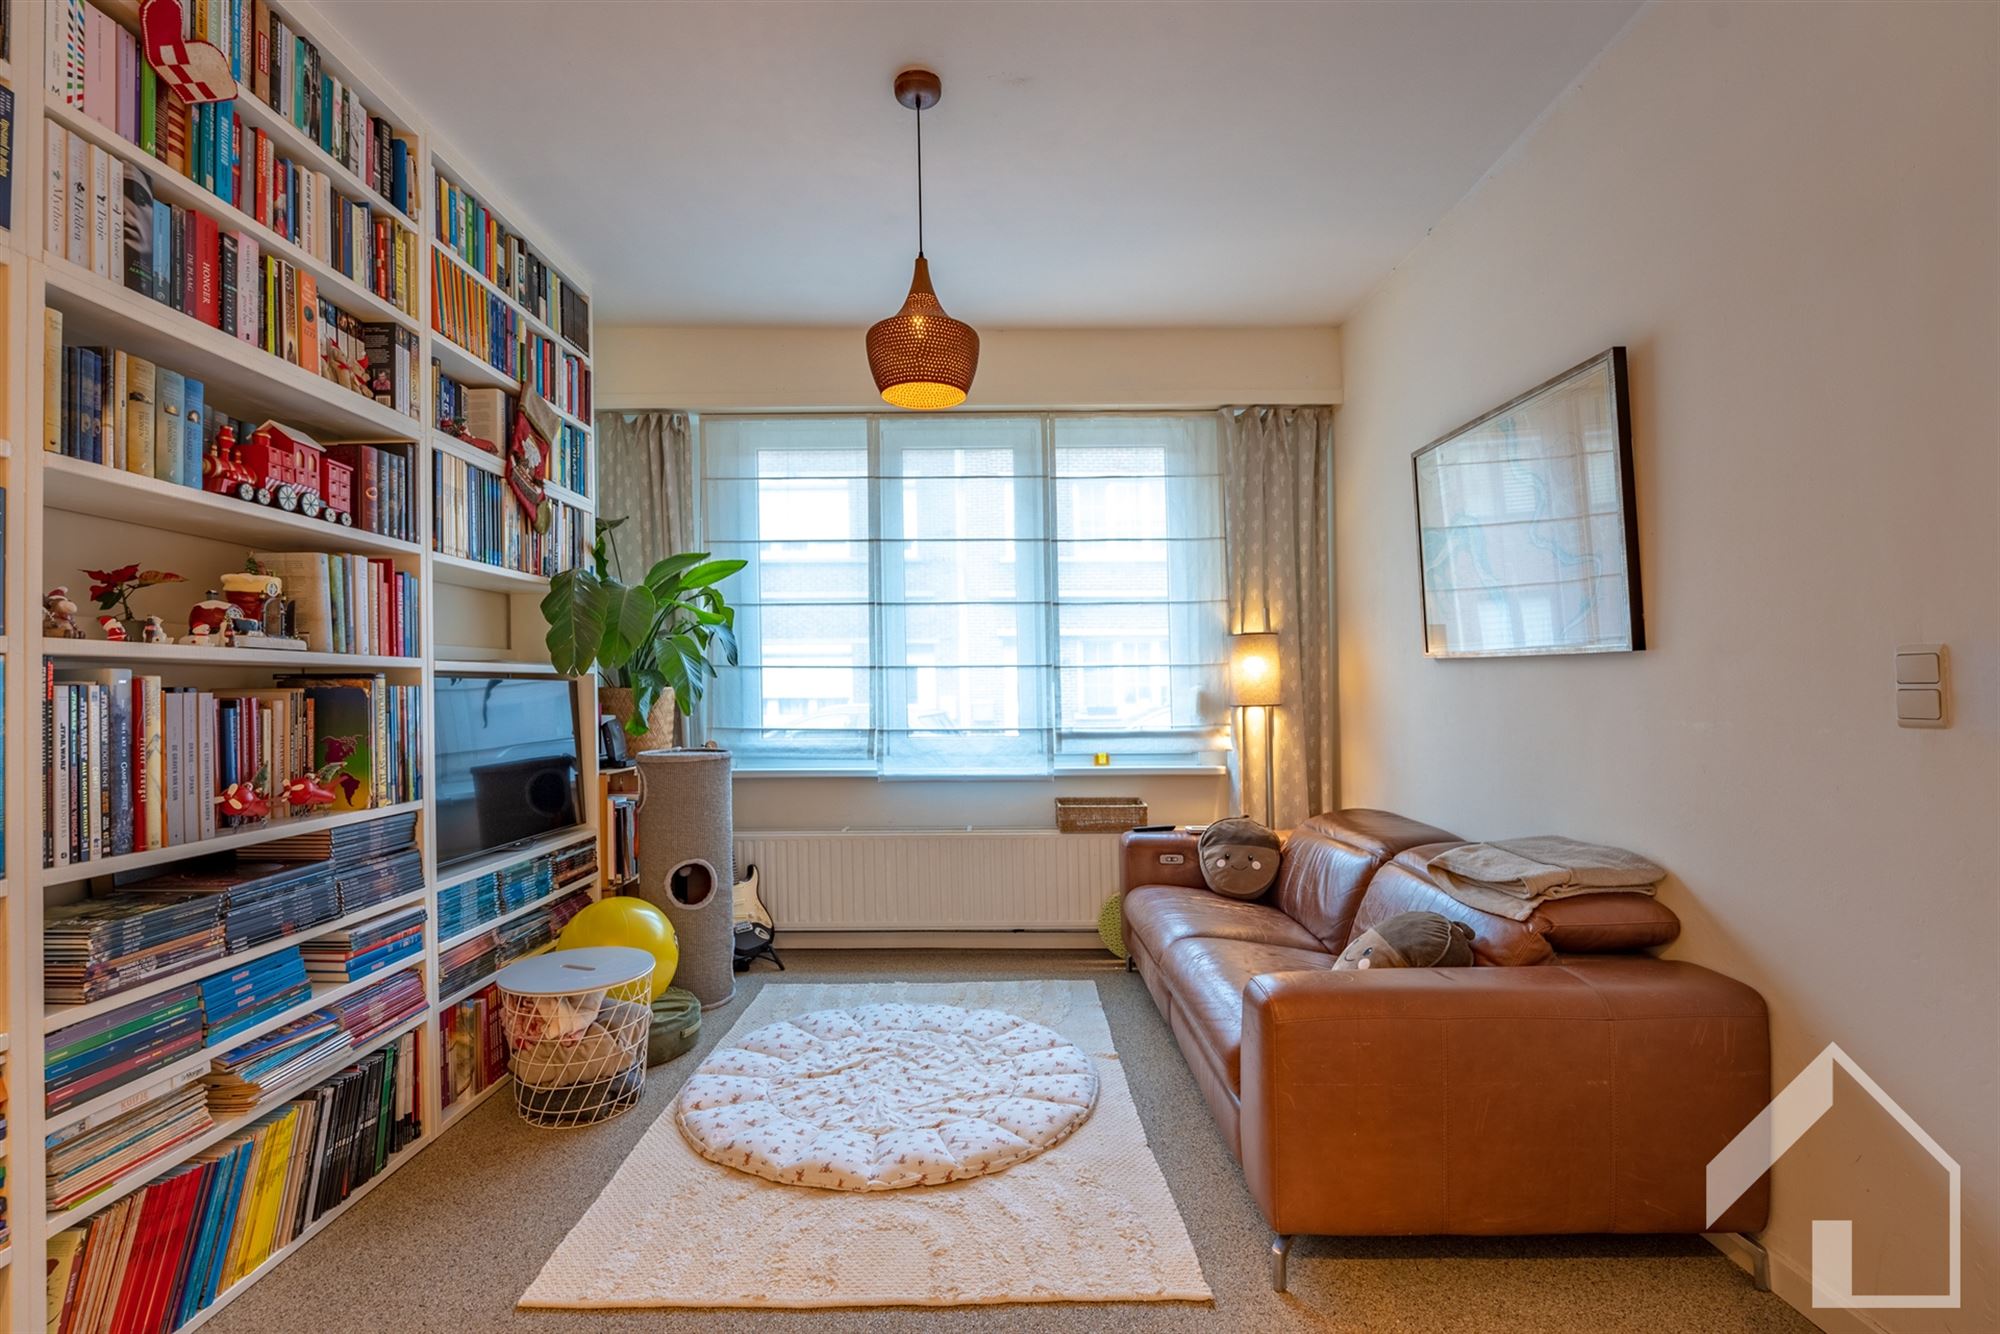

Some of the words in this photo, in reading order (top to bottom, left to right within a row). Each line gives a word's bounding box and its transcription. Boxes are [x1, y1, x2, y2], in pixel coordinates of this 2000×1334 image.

[51, 185, 63, 233] Mythos
[74, 195, 84, 241] Helden
[96, 208, 107, 240] Troje
[113, 222, 121, 260] Odyssee
[186, 265, 194, 292] PLAAG
[202, 261, 211, 304] HONGER
[101, 691, 109, 718] STAR
[101, 717, 109, 744] WARS
[101, 744, 109, 770] ROGUE
[139, 737, 147, 764] Pieter
[101, 771, 109, 788] ONE
[138, 768, 147, 802] Bruegel
